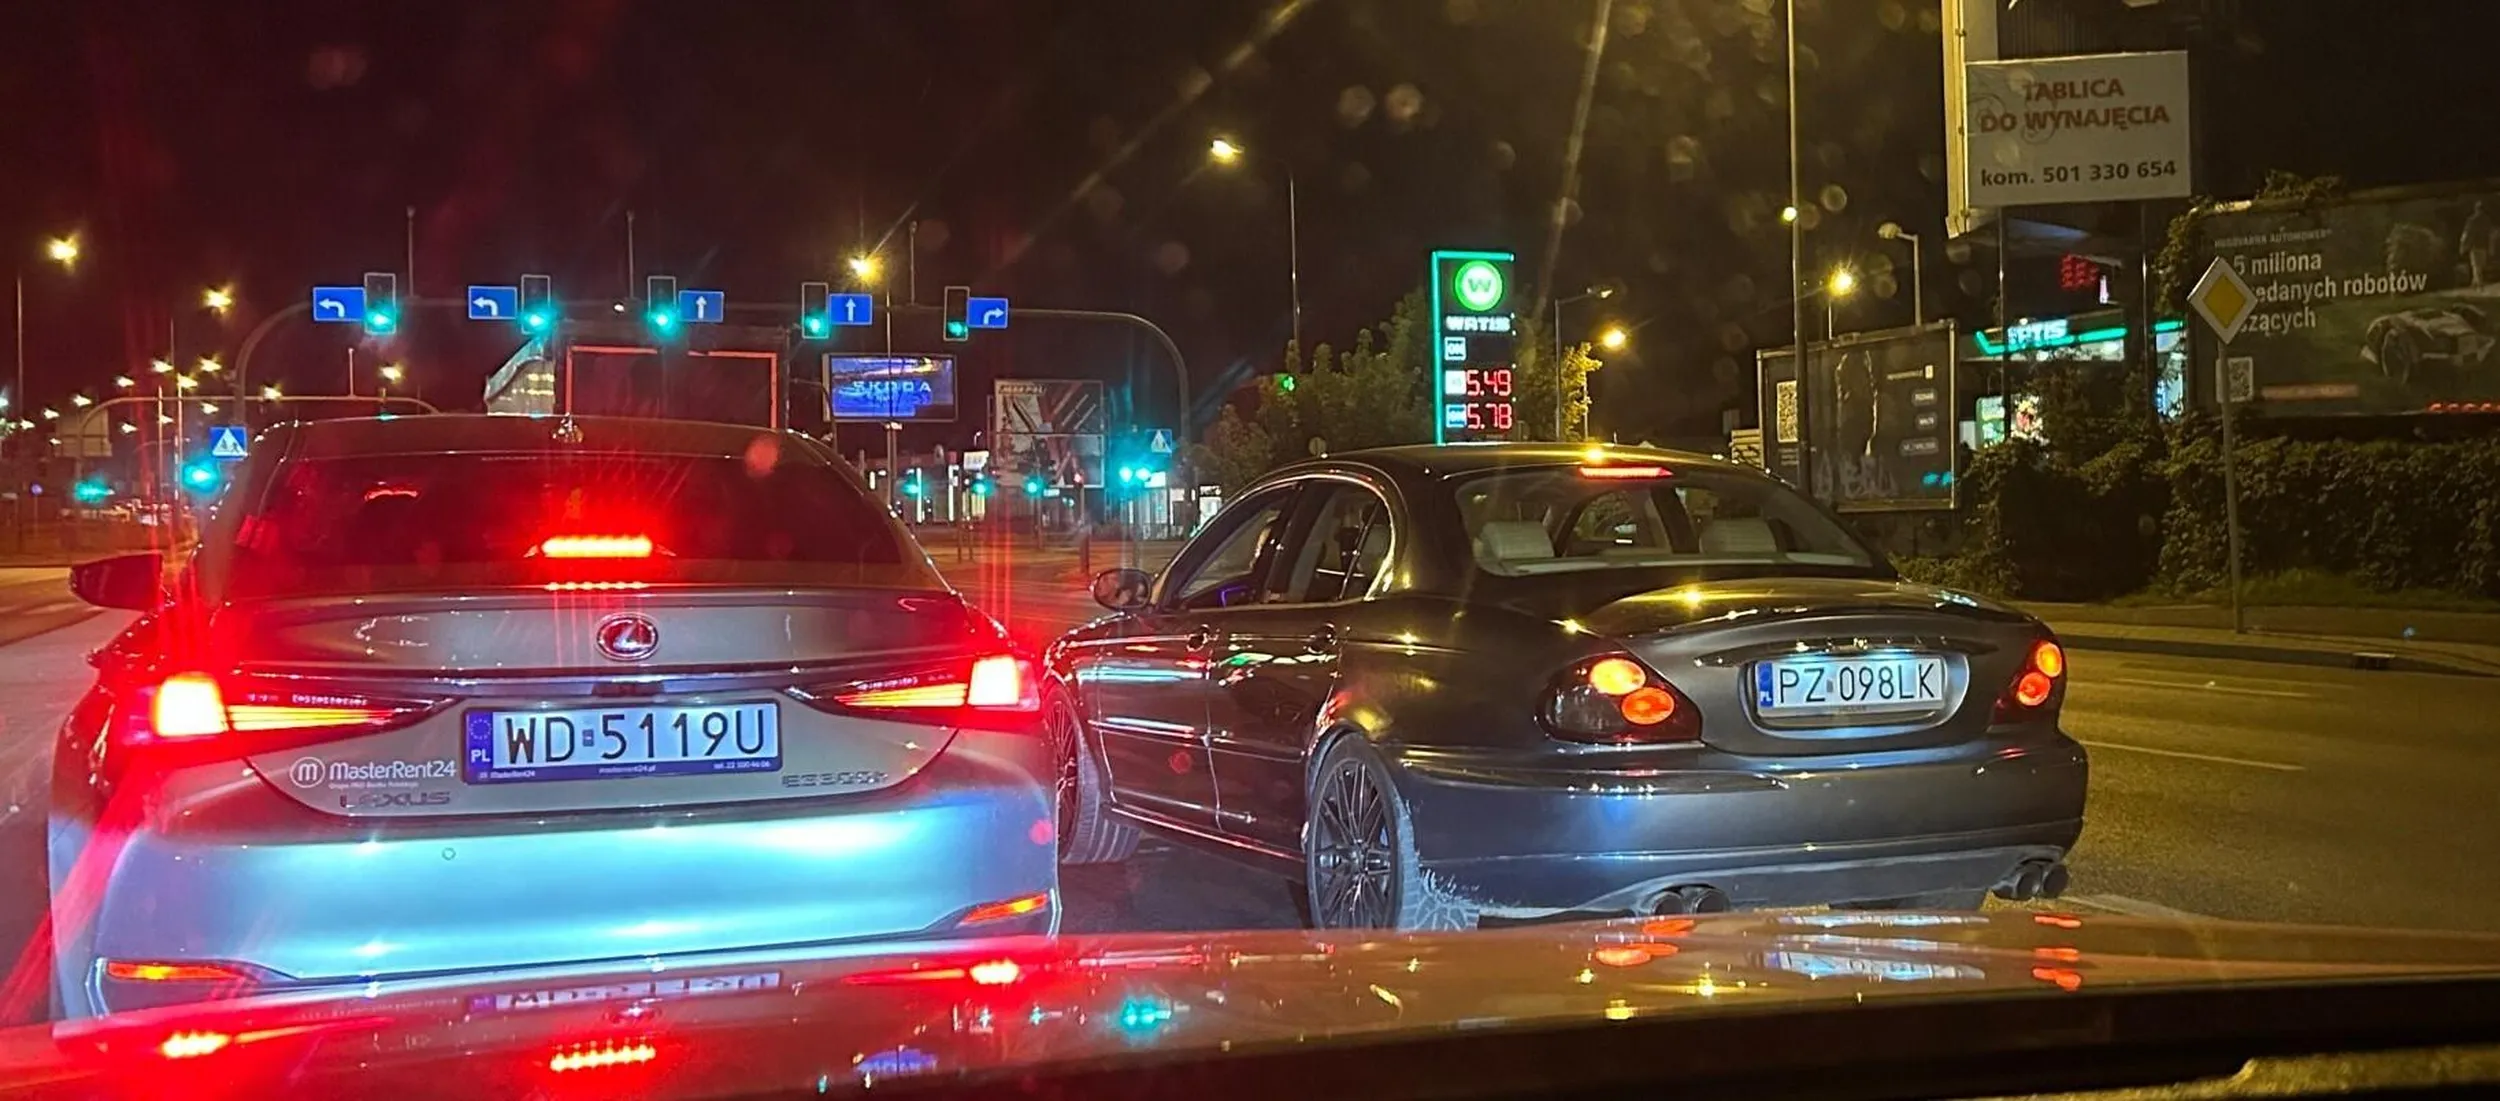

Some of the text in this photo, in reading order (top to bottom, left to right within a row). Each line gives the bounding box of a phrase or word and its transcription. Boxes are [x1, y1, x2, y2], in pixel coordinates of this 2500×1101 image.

[2024, 78, 2125, 101] TABLICA
[1980, 104, 2170, 133] DO WYNAJĘCIA
[1981, 160, 2176, 187] kom. 501 330 654
[2251, 251, 2322, 275] miliona
[2251, 269, 2428, 304] edanych robotów
[1466, 369, 1512, 397] 5.49
[1466, 402, 1512, 430] 5.78
[1759, 690, 1772, 703] PL
[1779, 662, 1935, 704] PZ 098LK
[505, 708, 765, 765] WD 5119U
[470, 748, 491, 763] PL
[328, 759, 457, 780] MasterRent24
[339, 790, 451, 808] LEXUS
